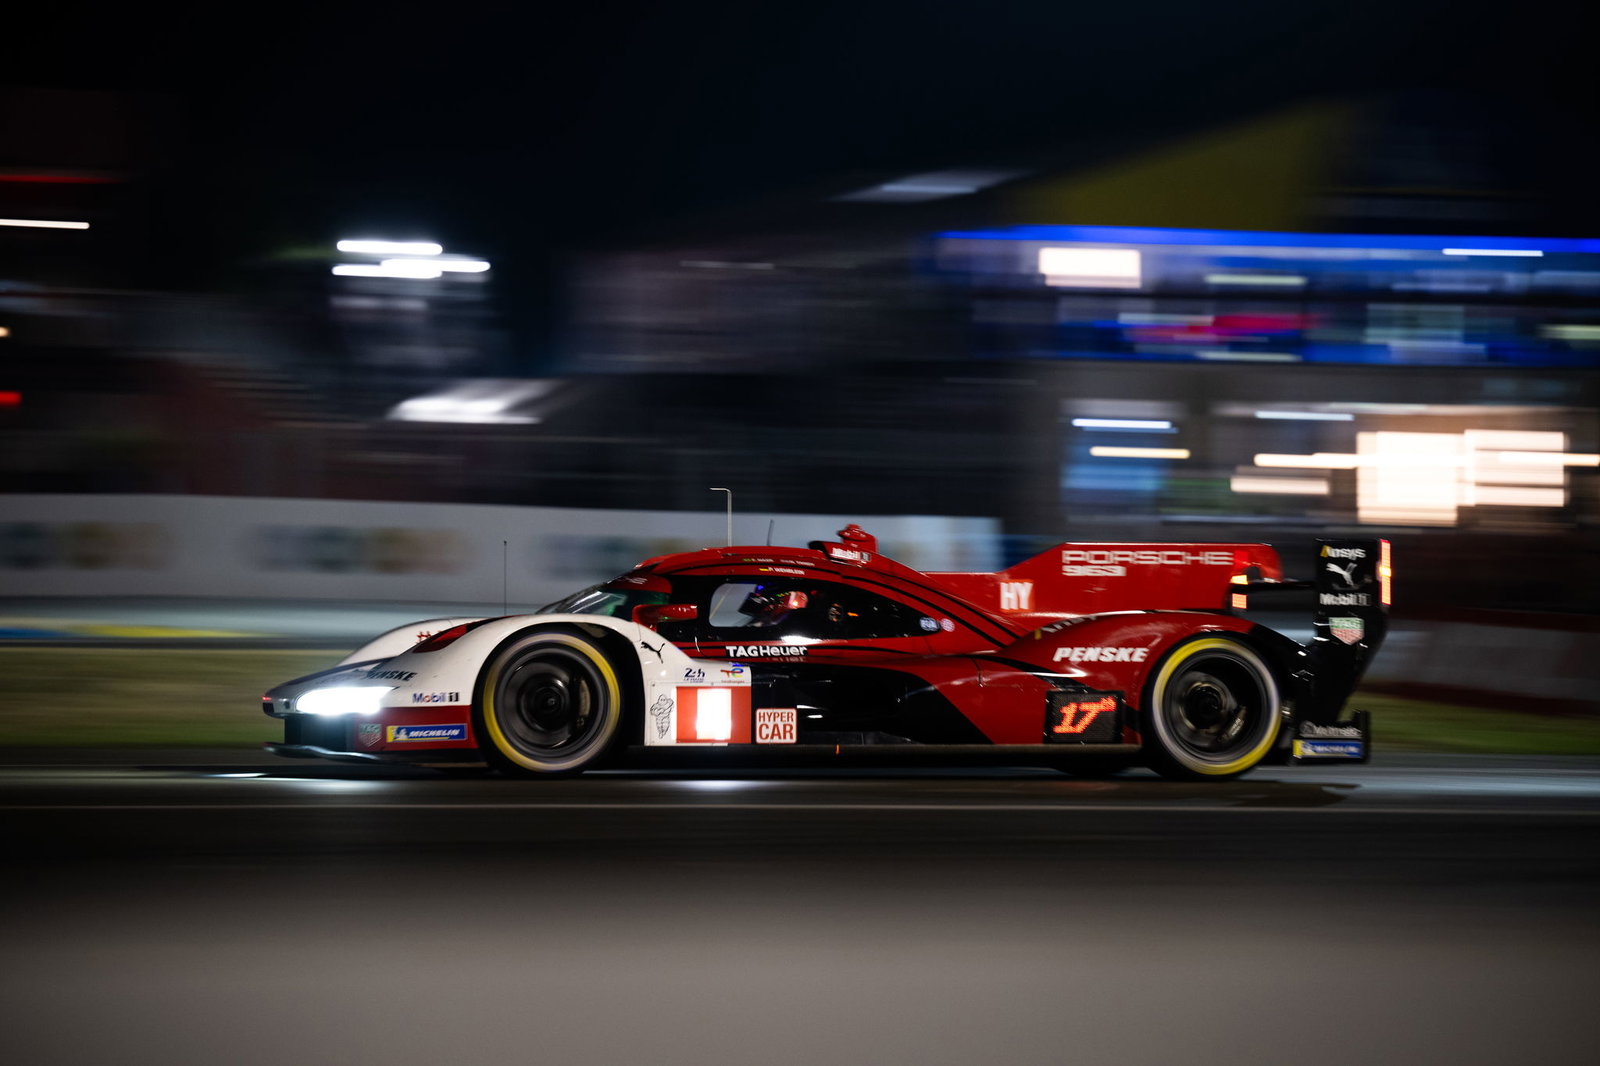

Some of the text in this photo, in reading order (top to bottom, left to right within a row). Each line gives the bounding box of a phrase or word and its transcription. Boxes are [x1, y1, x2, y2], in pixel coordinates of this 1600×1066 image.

[1062, 550, 1234, 566] PORSCHE
[1000, 582, 1034, 611] HY
[1053, 646, 1150, 663] PENSKE
[412, 692, 446, 704] Mobil
[758, 711, 795, 722] HYPER
[409, 729, 461, 738] MICHELIN
[759, 723, 794, 741] CAR
